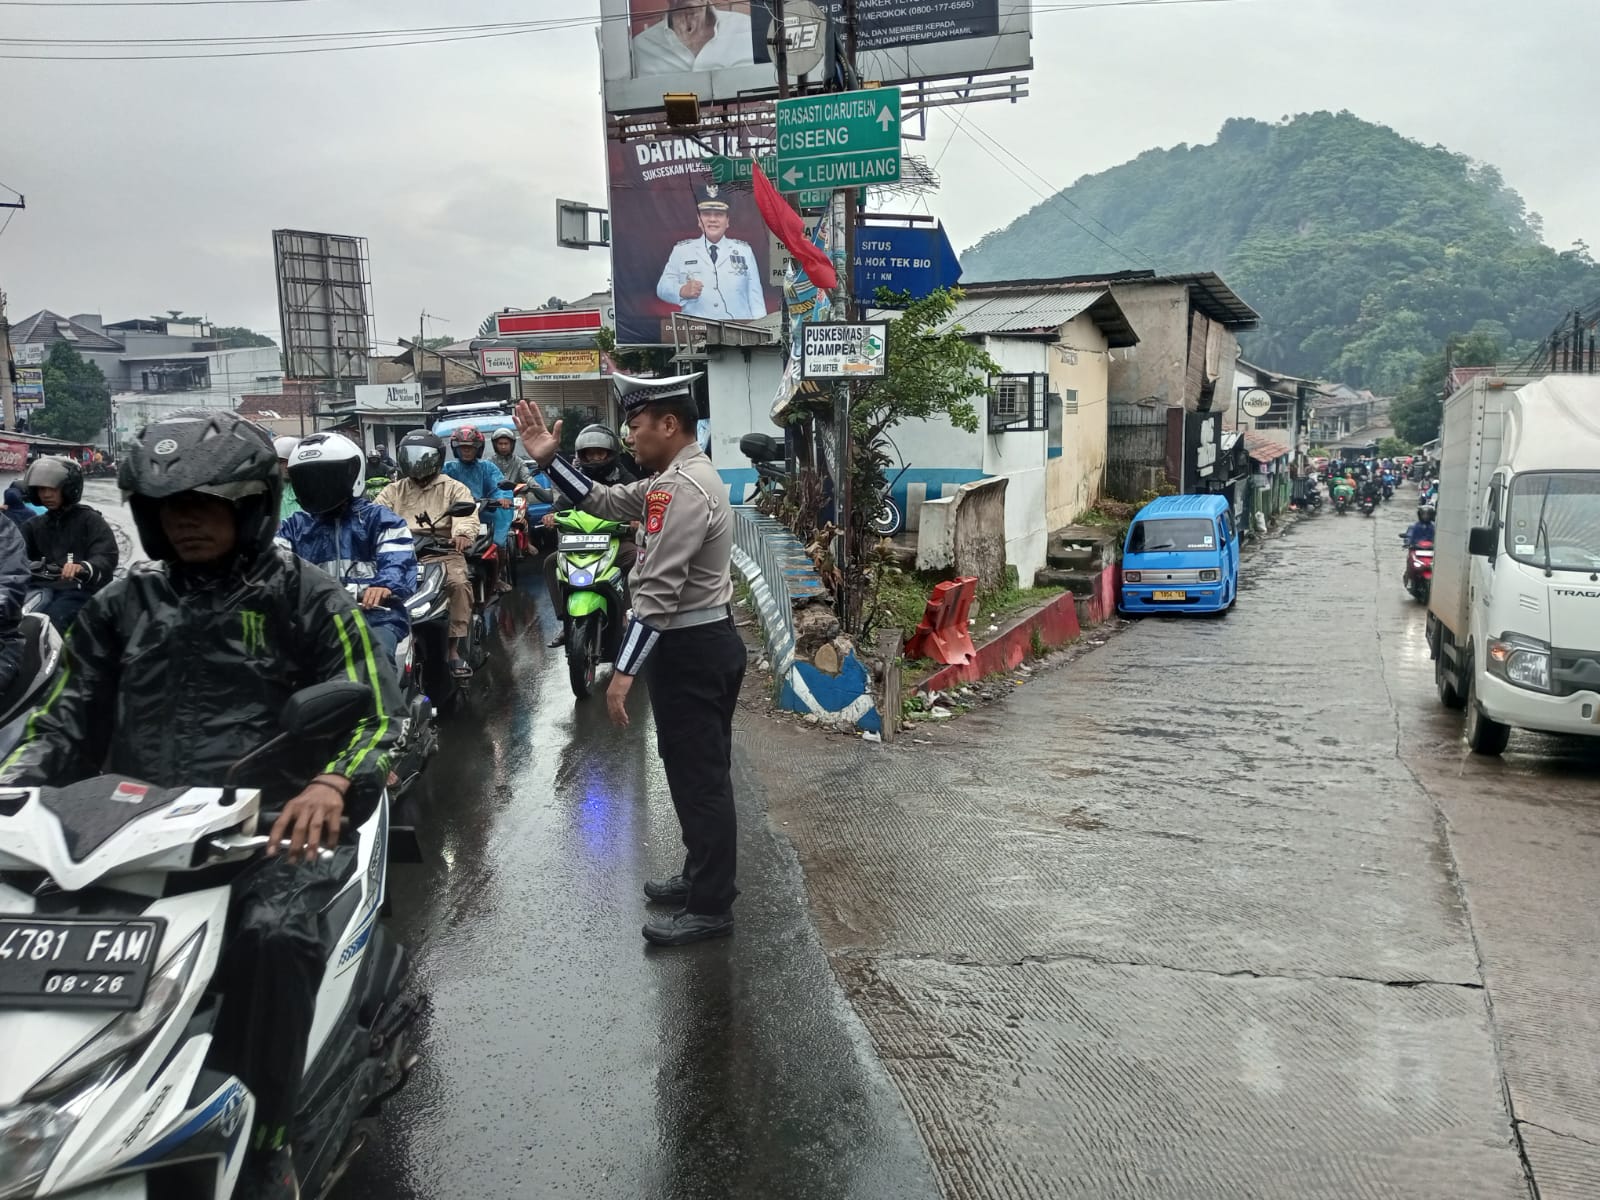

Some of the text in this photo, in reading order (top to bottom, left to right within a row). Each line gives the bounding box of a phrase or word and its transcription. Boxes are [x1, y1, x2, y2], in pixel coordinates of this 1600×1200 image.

[925, 20, 956, 30] KEPADA
[900, 30, 948, 43] PEREMPUAN
[779, 102, 823, 126] PRASASTI
[824, 98, 876, 122] CIARUTEUN
[779, 127, 850, 152] CISEENG
[642, 163, 684, 182] SUKSESKAN
[808, 158, 896, 183] LEUWILIANG
[862, 241, 892, 251] SITUS
[890, 258, 910, 268] TEK
[913, 259, 931, 268] BIO
[807, 327, 862, 342] PUSKESMAS
[806, 343, 856, 356] CIAMPEA
